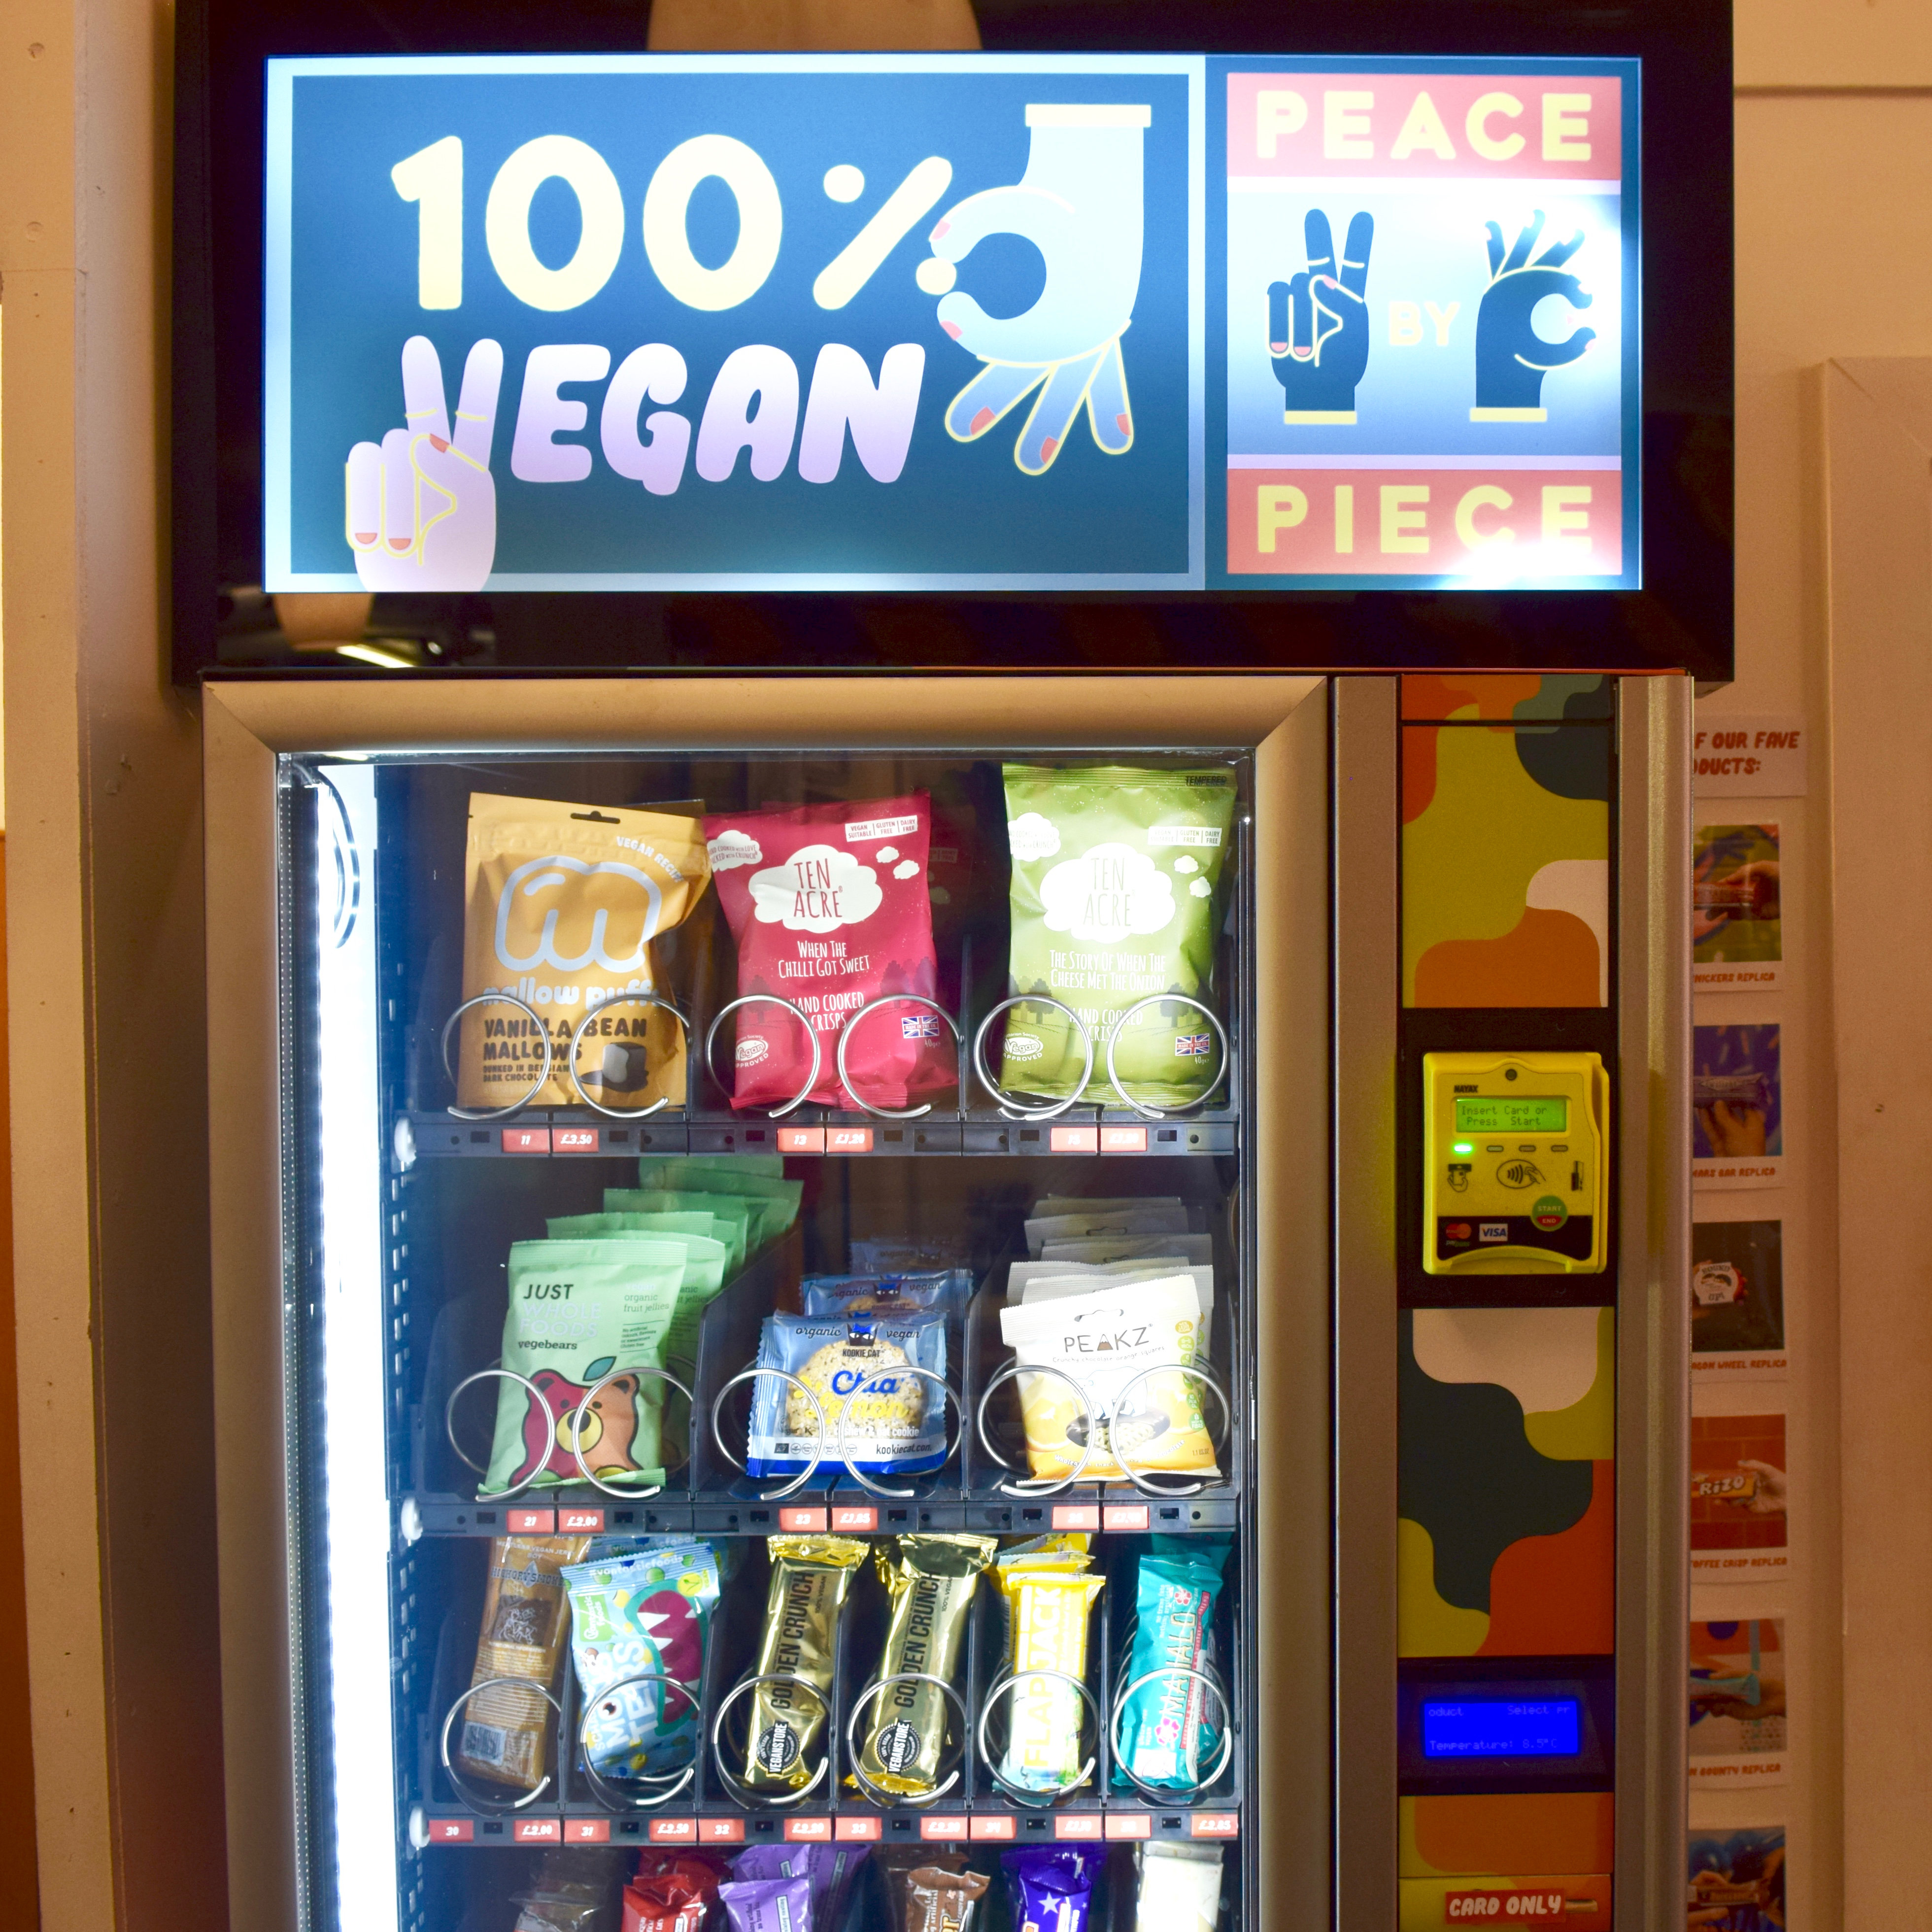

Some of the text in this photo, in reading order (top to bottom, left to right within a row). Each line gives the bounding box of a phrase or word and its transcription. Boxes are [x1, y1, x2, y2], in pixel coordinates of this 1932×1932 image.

[1256, 91, 1592, 161] PEACE
[390, 134, 956, 311] 100%
[1389, 301, 1460, 346] BY
[402, 336, 925, 496] VEGAN
[1257, 484, 1592, 553] PIECE
[1712, 732, 1748, 748] OUR
[1755, 731, 1800, 749] FAVE
[616, 836, 654, 857] VEGAN
[793, 858, 830, 889] TEN
[1090, 858, 1125, 890] TEN
[1694, 972, 1775, 983] NICKERS REPLICA
[823, 992, 864, 1012] COOKED
[484, 1017, 647, 1038] VANILLA BEAN
[811, 1012, 846, 1031] CRISPS
[484, 1041, 582, 1060] MALLOWS
[736, 1044, 764, 1060] Vegan
[1006, 1038, 1038, 1053] Vegan
[736, 1053, 768, 1068] PPROVED
[1003, 1052, 1042, 1061] APPROVED
[483, 1073, 502, 1082] DARK
[1461, 1106, 1547, 1116] Insert Card or
[1467, 1118, 1541, 1126] Press Start
[521, 1135, 530, 1145] 11
[561, 1134, 592, 1144] £3.50
[794, 1134, 807, 1145] 13
[835, 1134, 865, 1144] £1.20
[1739, 1168, 1775, 1177] REPLICA
[1482, 1228, 1507, 1237] VISA
[523, 1284, 574, 1299] JUST
[624, 1294, 658, 1303] organic
[523, 1301, 601, 1319] WHOLE
[624, 1303, 669, 1313] fruit jellies
[519, 1318, 597, 1337] FOODS
[796, 1326, 920, 1342] organic vegan
[518, 1340, 577, 1350] vegebears
[1141, 1346, 1164, 1356] squares
[1692, 1359, 1787, 1370] AGON WHEEL REPLICA
[892, 1427, 919, 1436] cookie
[524, 1516, 536, 1526] 21
[567, 1515, 597, 1526] £2.00
[796, 1514, 811, 1525] 23
[1723, 1559, 1748, 1567] CRISP
[1751, 1557, 1787, 1566] REPLICA
[491, 1566, 527, 1581] HICKORY
[818, 1576, 826, 1597] VEGAN
[782, 1571, 814, 1639] CRUNCH
[909, 1570, 940, 1637] CRUNCH
[942, 1596, 950, 1612] 100%
[1156, 1598, 1165, 1614] trans
[596, 1601, 606, 1627] foods
[771, 1643, 800, 1709] GOLDEN
[894, 1641, 926, 1708] GOLDEN
[1024, 1587, 1061, 1766] FLAPJACK
[1429, 1707, 1463, 1716] oduct
[1508, 1705, 1549, 1715] Select
[769, 1723, 787, 1772] VEGANSTORE
[888, 1723, 909, 1771] VEGANSTORE
[1430, 1740, 1513, 1750] Temperature:
[1742, 1763, 1781, 1773] REPLICA
[446, 1826, 459, 1836] 30
[523, 1825, 552, 1836] £2.00
[581, 1826, 593, 1836] 31
[658, 1824, 689, 1834] £2.50
[714, 1824, 729, 1835] 32
[851, 1823, 866, 1833] 33
[985, 1822, 1001, 1833] 34
[1450, 1895, 1561, 1916] CARD ONLY
